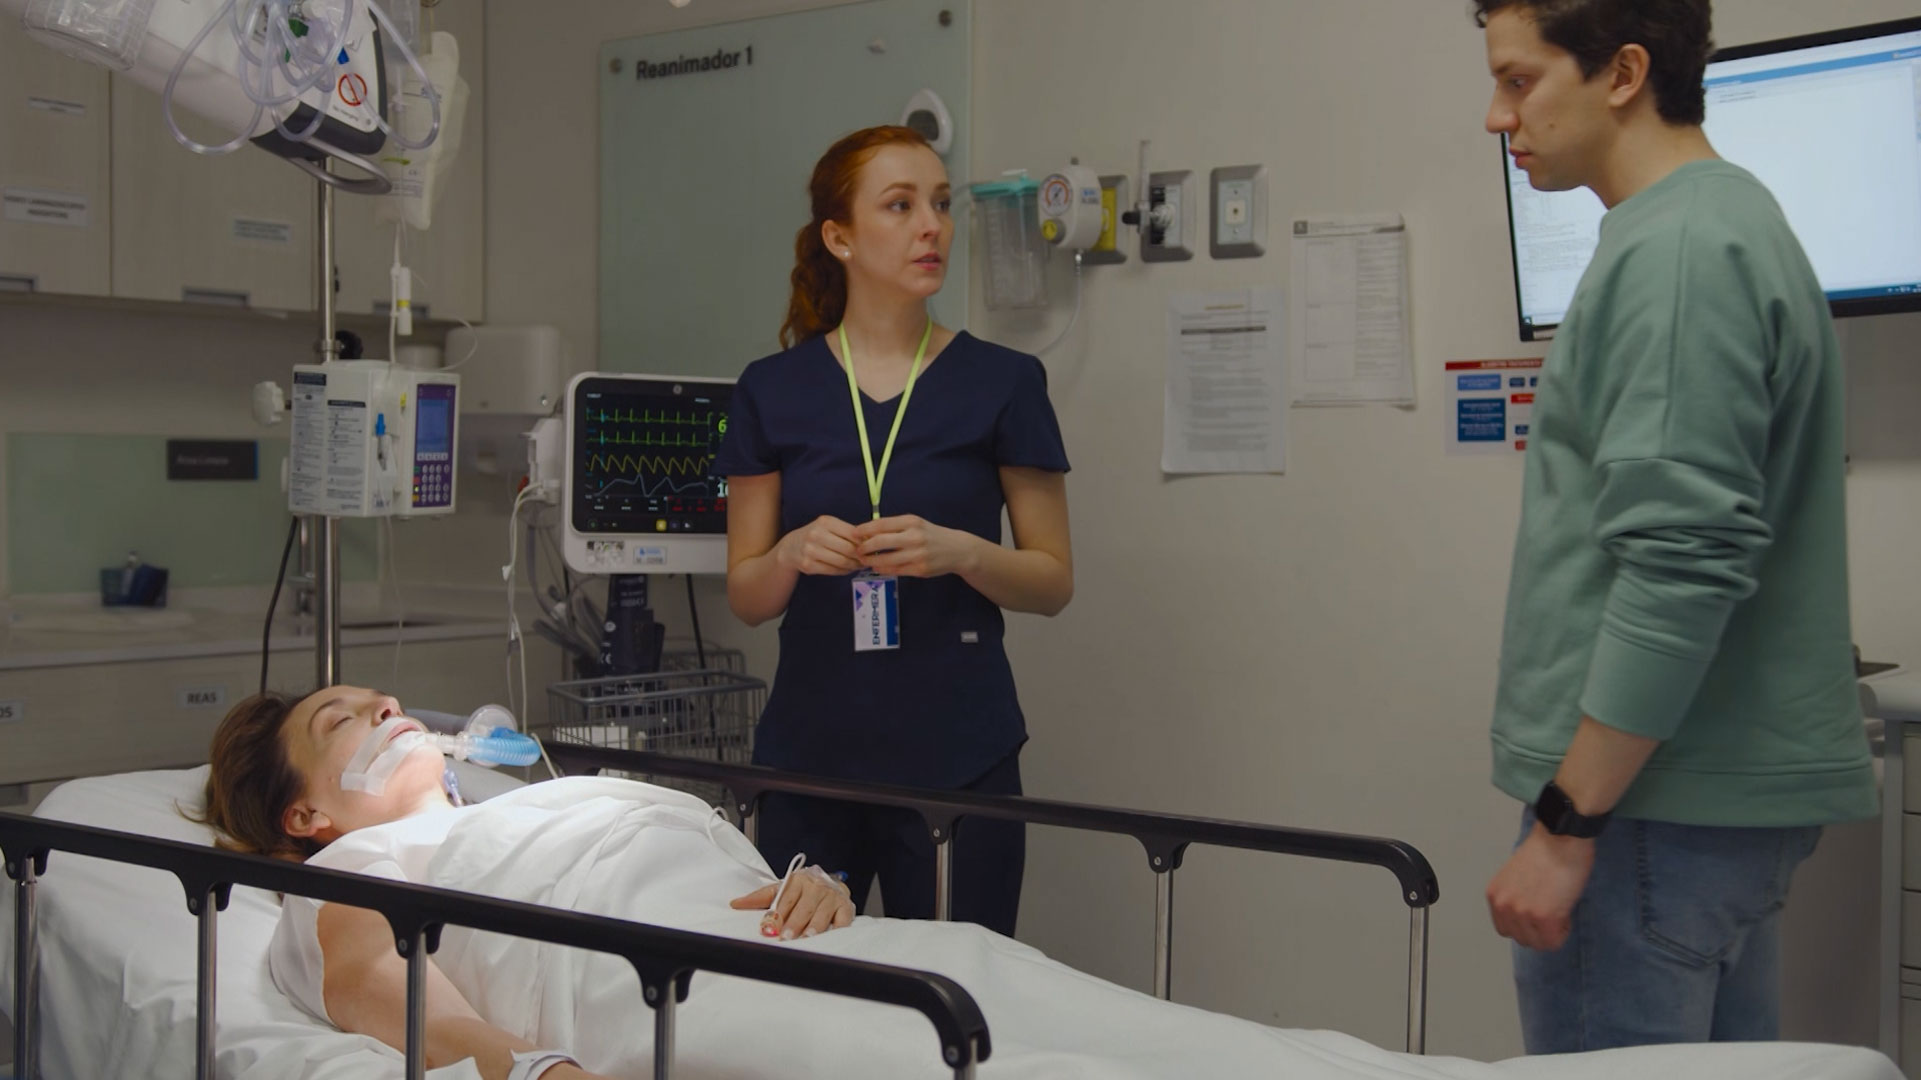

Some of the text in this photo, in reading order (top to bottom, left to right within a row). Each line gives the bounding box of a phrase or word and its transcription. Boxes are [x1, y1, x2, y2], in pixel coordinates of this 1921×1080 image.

[636, 45, 753, 80] Reanimador 1
[187, 692, 217, 705] REAS
